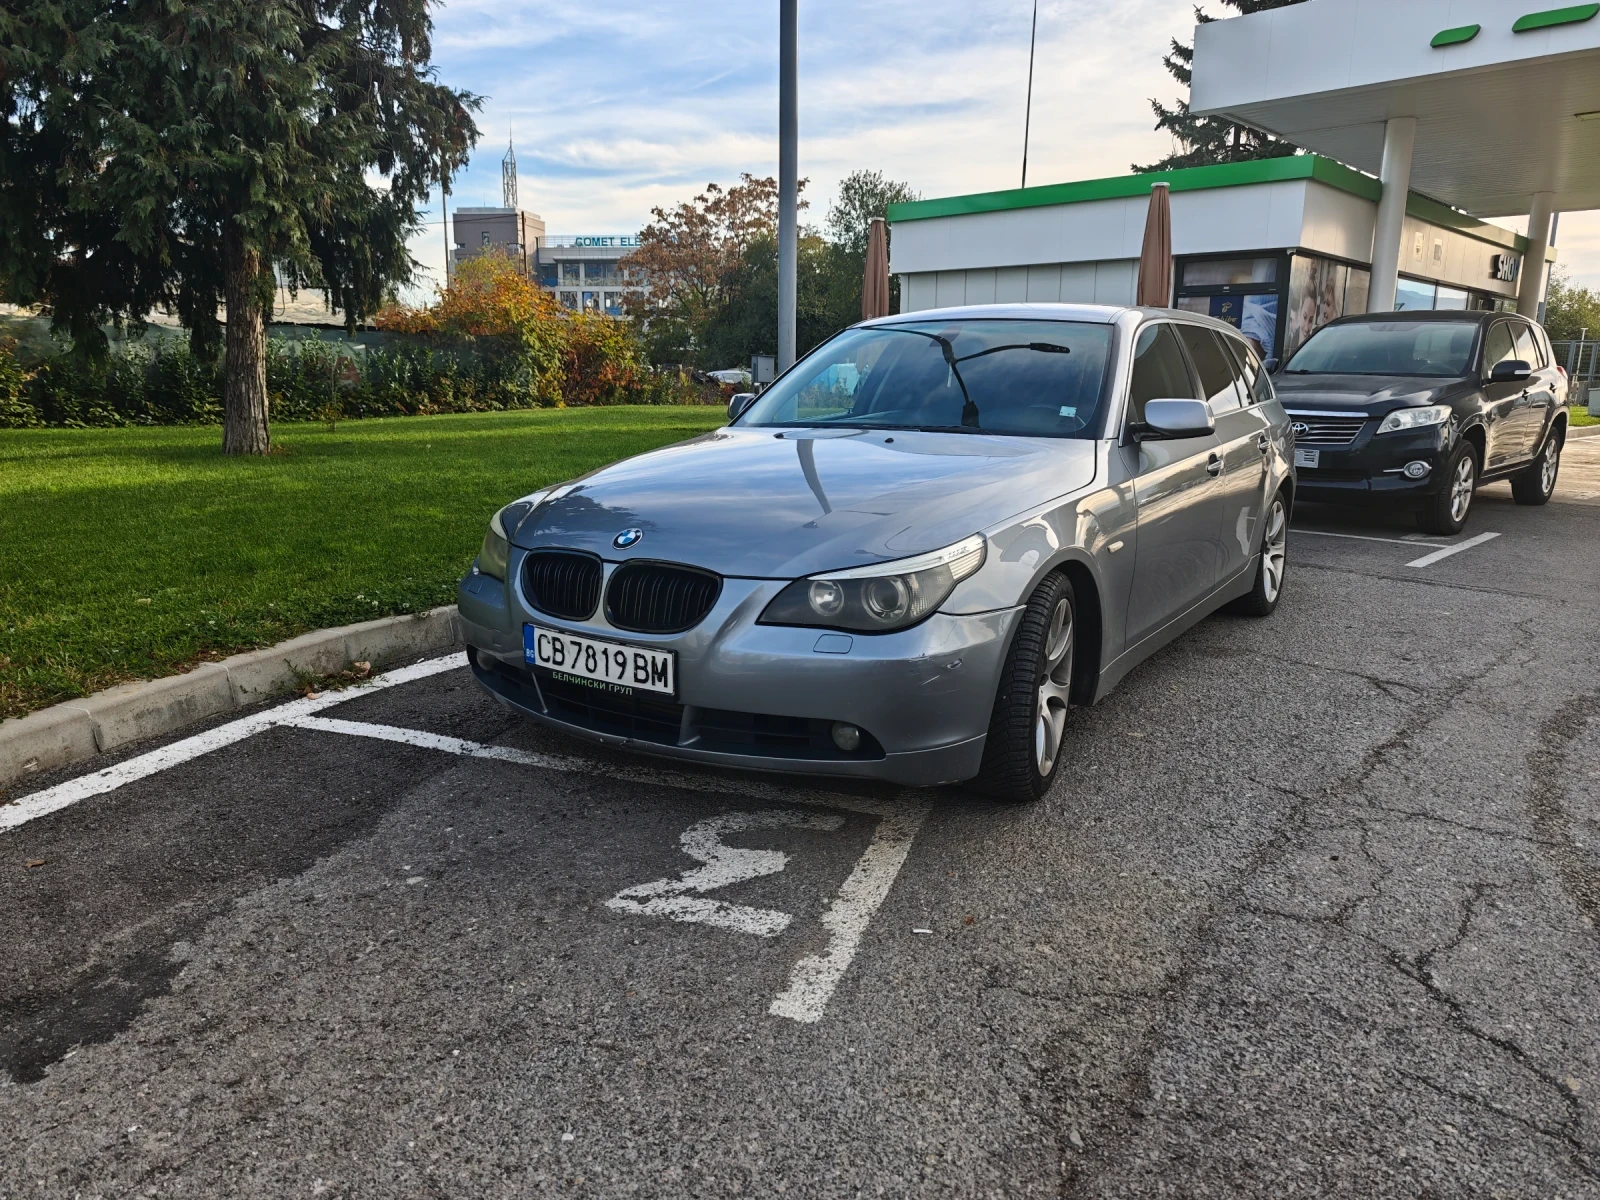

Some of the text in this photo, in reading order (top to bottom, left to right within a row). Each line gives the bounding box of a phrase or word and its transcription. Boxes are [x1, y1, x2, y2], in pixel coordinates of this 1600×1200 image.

[575, 236, 642, 247] COMET ELE
[537, 633, 669, 688] CB7819BM
[552, 671, 633, 695] БЕЛЧИНСКИ ГРУП
